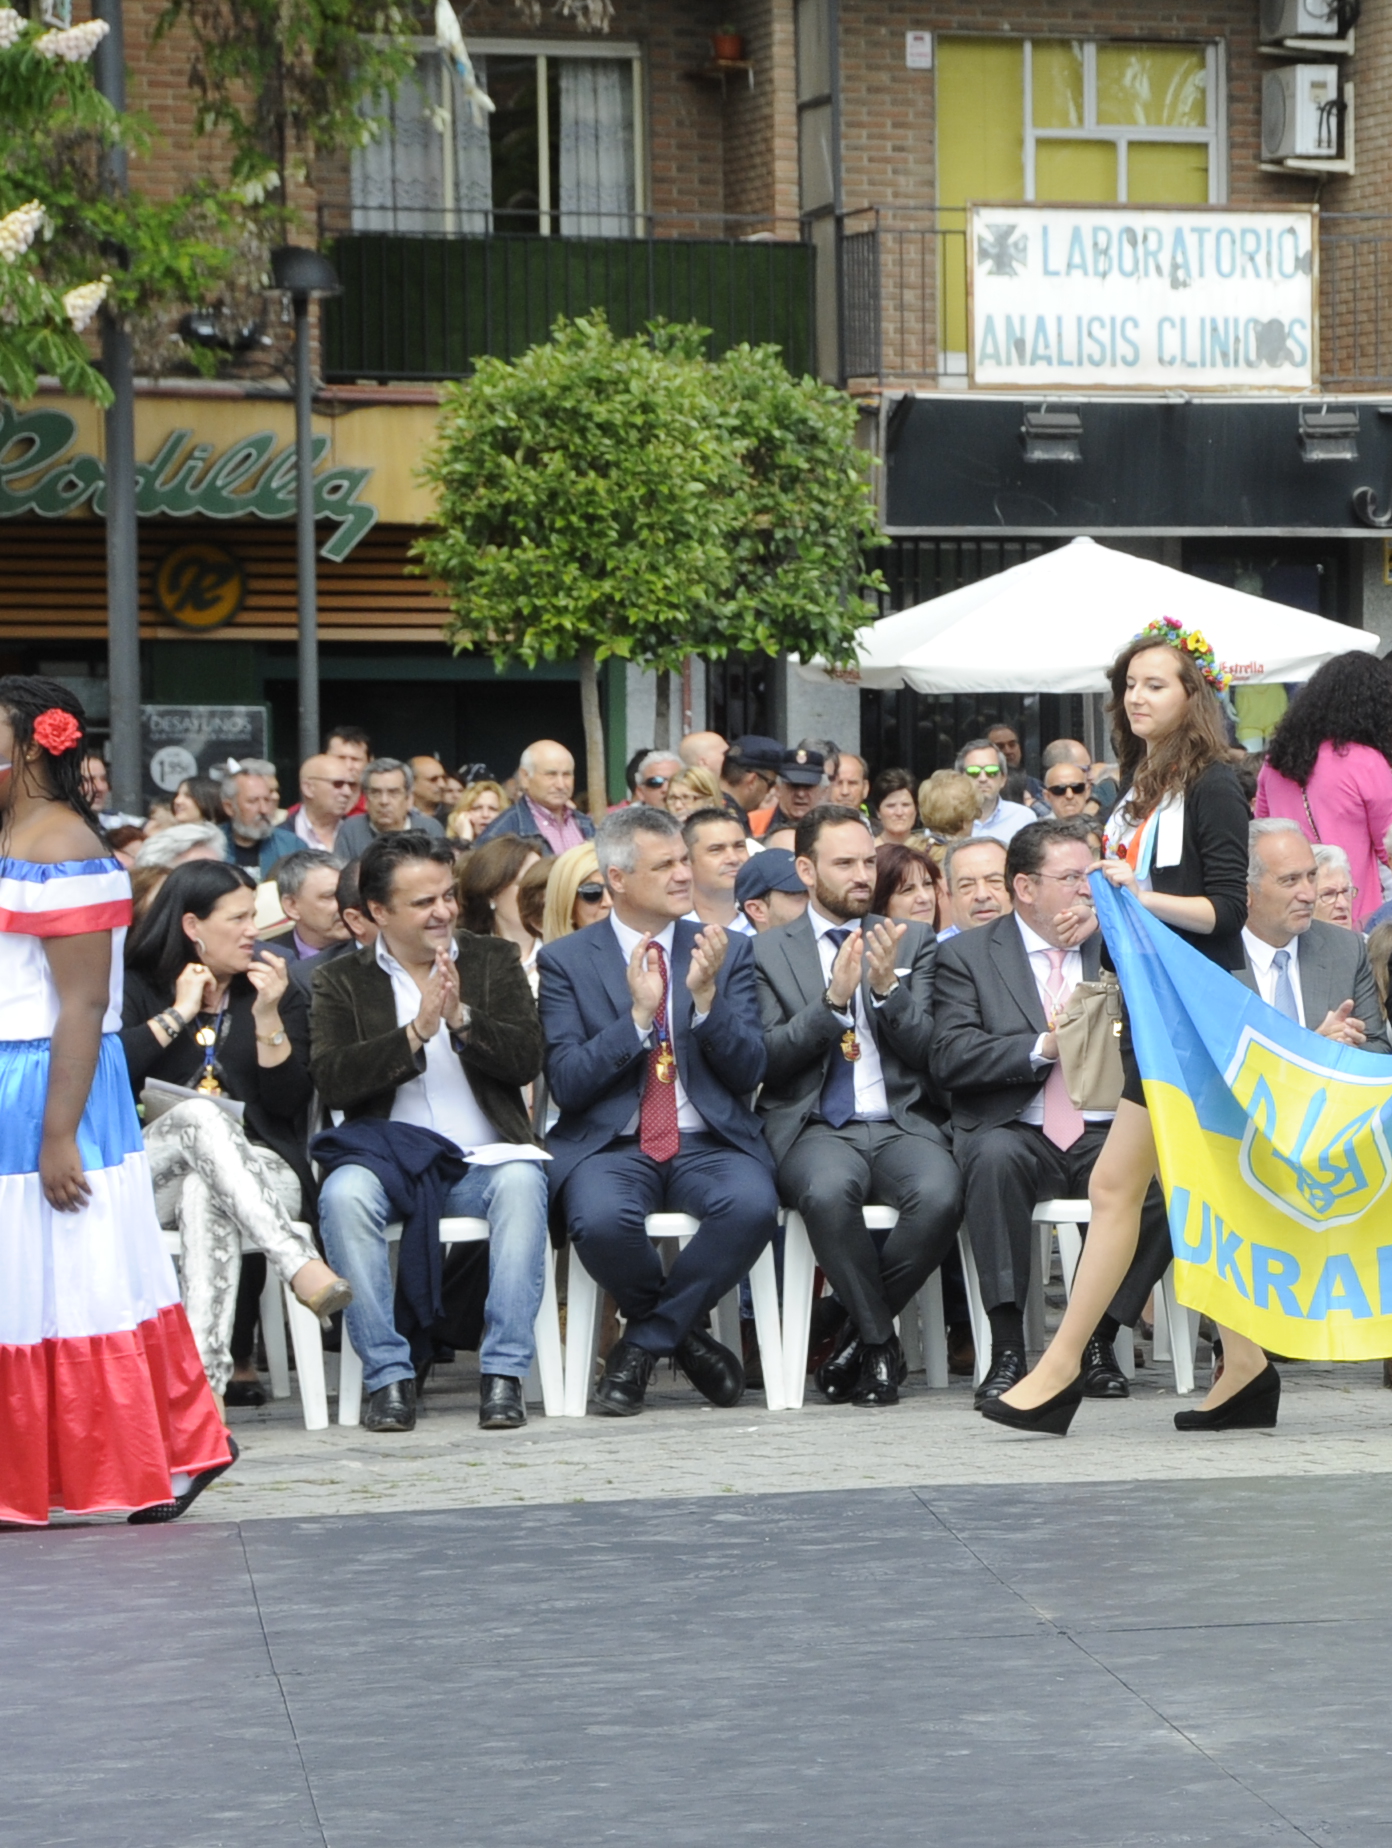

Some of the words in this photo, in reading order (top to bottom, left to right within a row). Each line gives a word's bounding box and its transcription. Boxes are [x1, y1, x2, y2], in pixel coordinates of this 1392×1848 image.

[1041, 225, 1299, 279] LABORATORIO
[977, 314, 1141, 367] ANALISIS
[1156, 315, 1308, 369] CLINICS
[150, 715, 253, 733] DESAYUNOS
